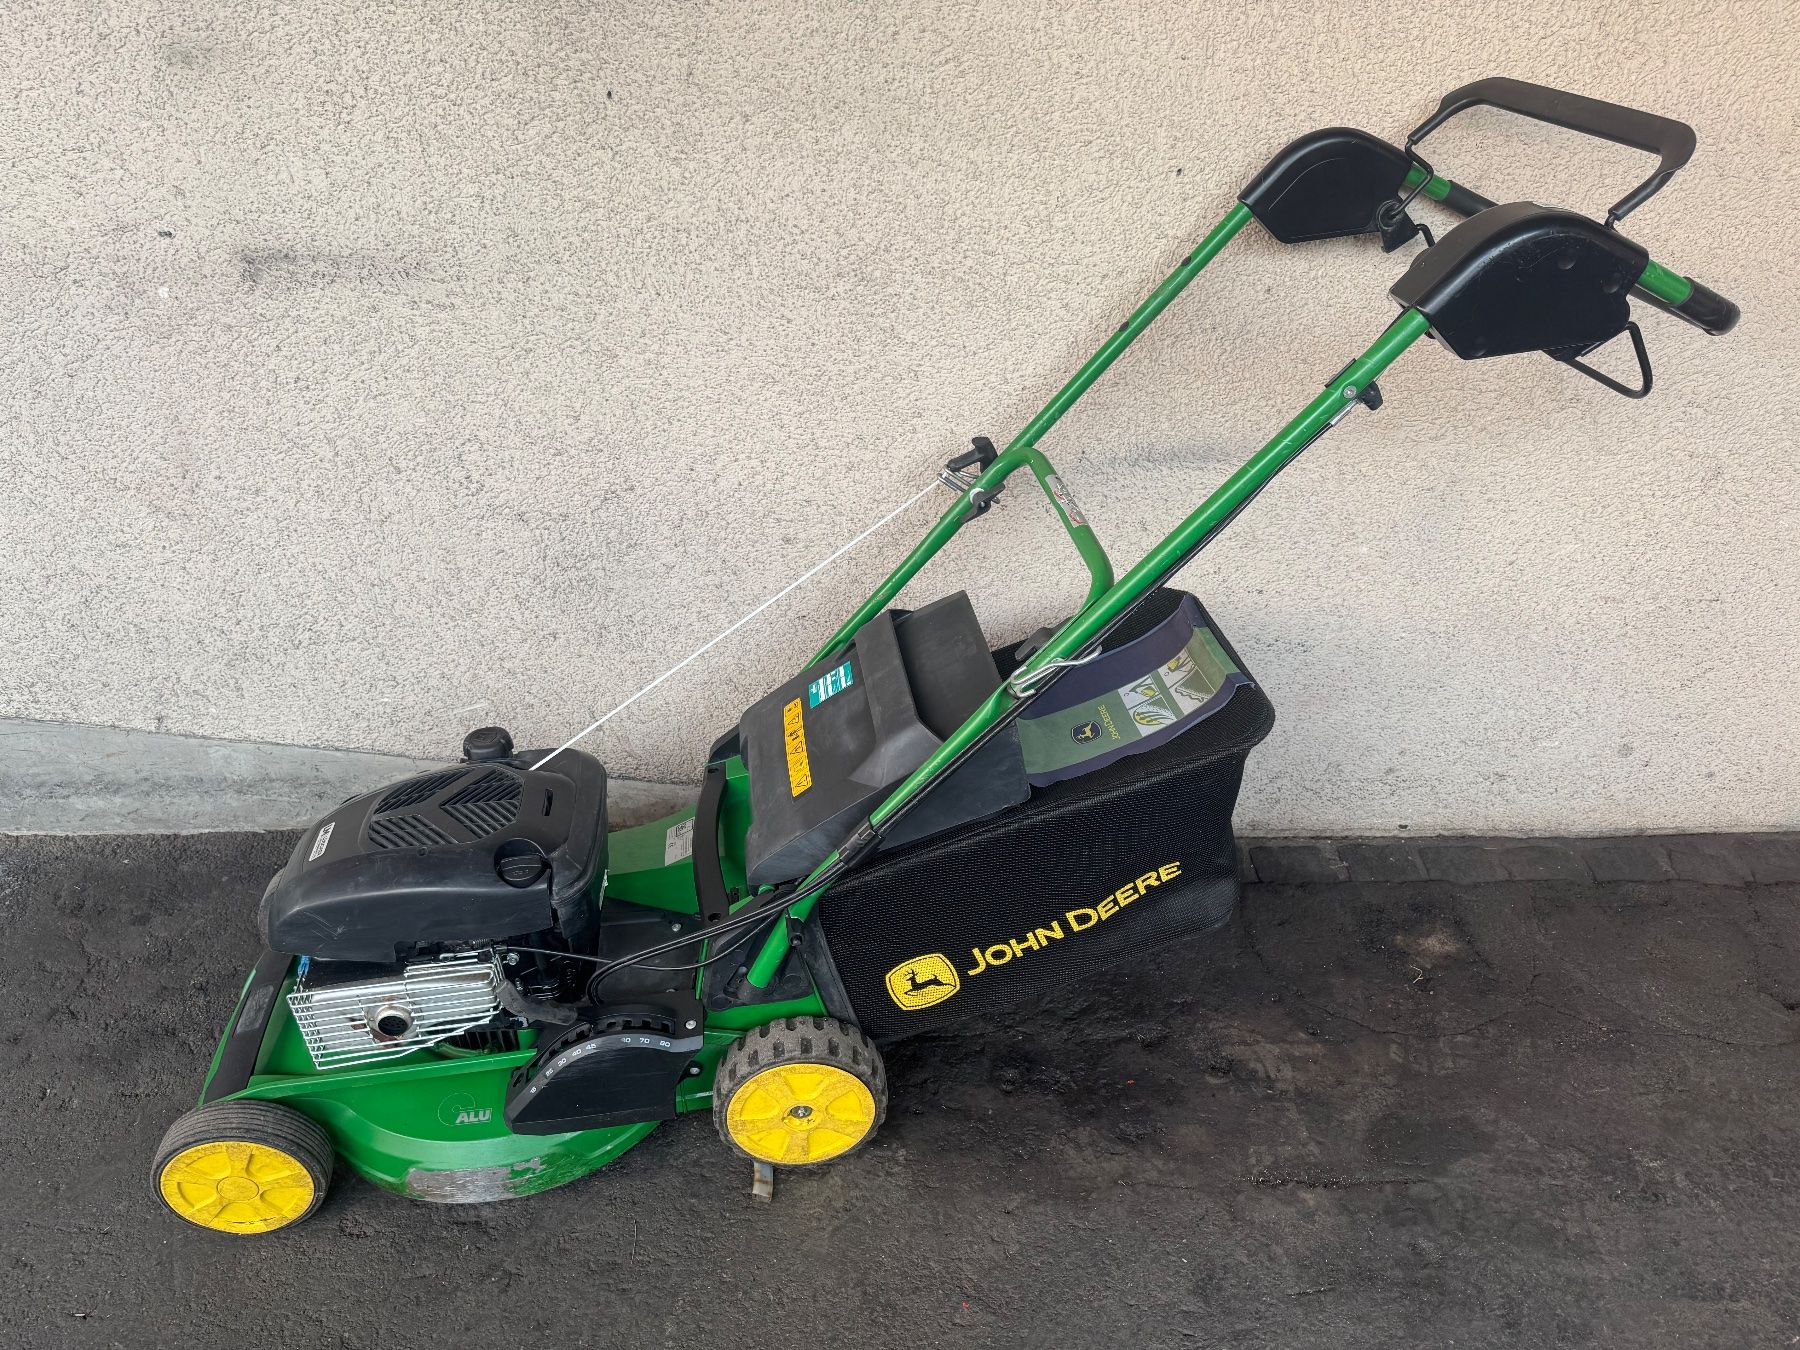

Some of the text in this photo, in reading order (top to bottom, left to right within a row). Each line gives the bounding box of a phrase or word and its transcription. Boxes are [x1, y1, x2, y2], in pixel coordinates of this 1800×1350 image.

[967, 861, 1182, 976] JOHN DEERE
[455, 1109, 491, 1124] ALU
